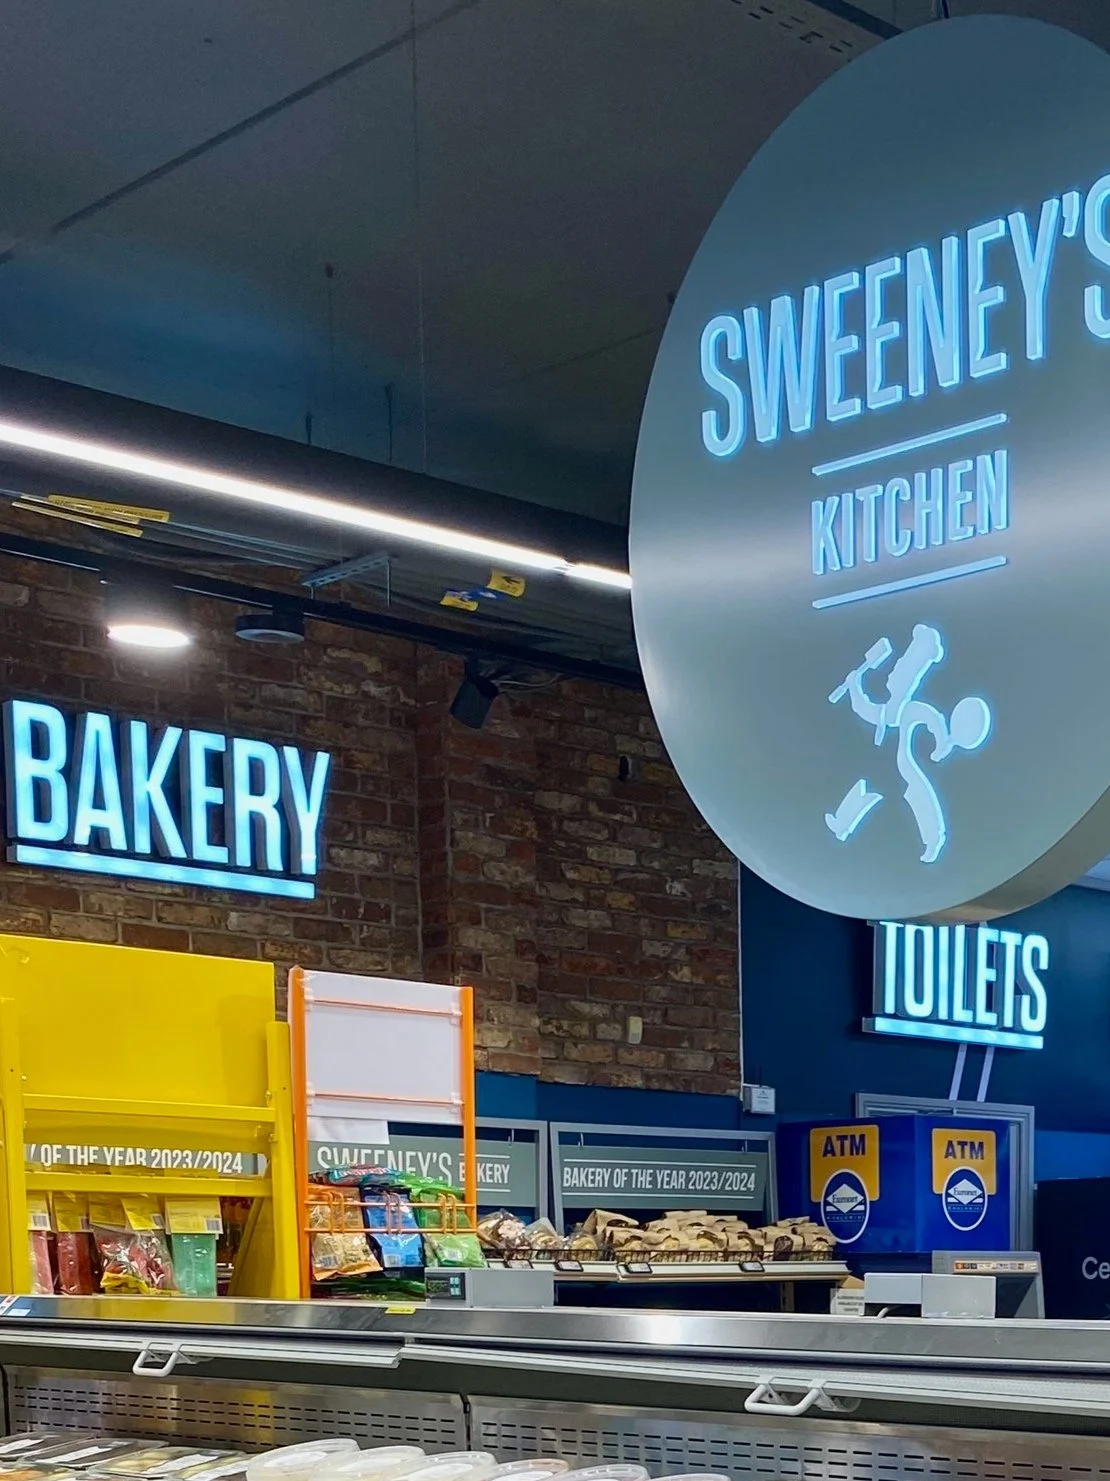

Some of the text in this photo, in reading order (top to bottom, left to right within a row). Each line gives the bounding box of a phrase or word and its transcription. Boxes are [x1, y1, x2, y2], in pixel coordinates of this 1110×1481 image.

[811, 450, 1010, 575] KITCHEN
[10, 699, 331, 876] BAKERY
[878, 920, 1049, 1033] TOILETS
[40, 1143, 62, 1167] OF
[65, 1144, 99, 1167] THE
[103, 1146, 146, 1167] YEAR
[151, 1148, 243, 1174] 2023/2024
[822, 1133, 866, 1158] ATM
[944, 1140, 985, 1160] ATM
[458, 1161, 510, 1184] BKERY
[563, 1167, 756, 1192] BAKERY OF THE YEAR 2023/2024
